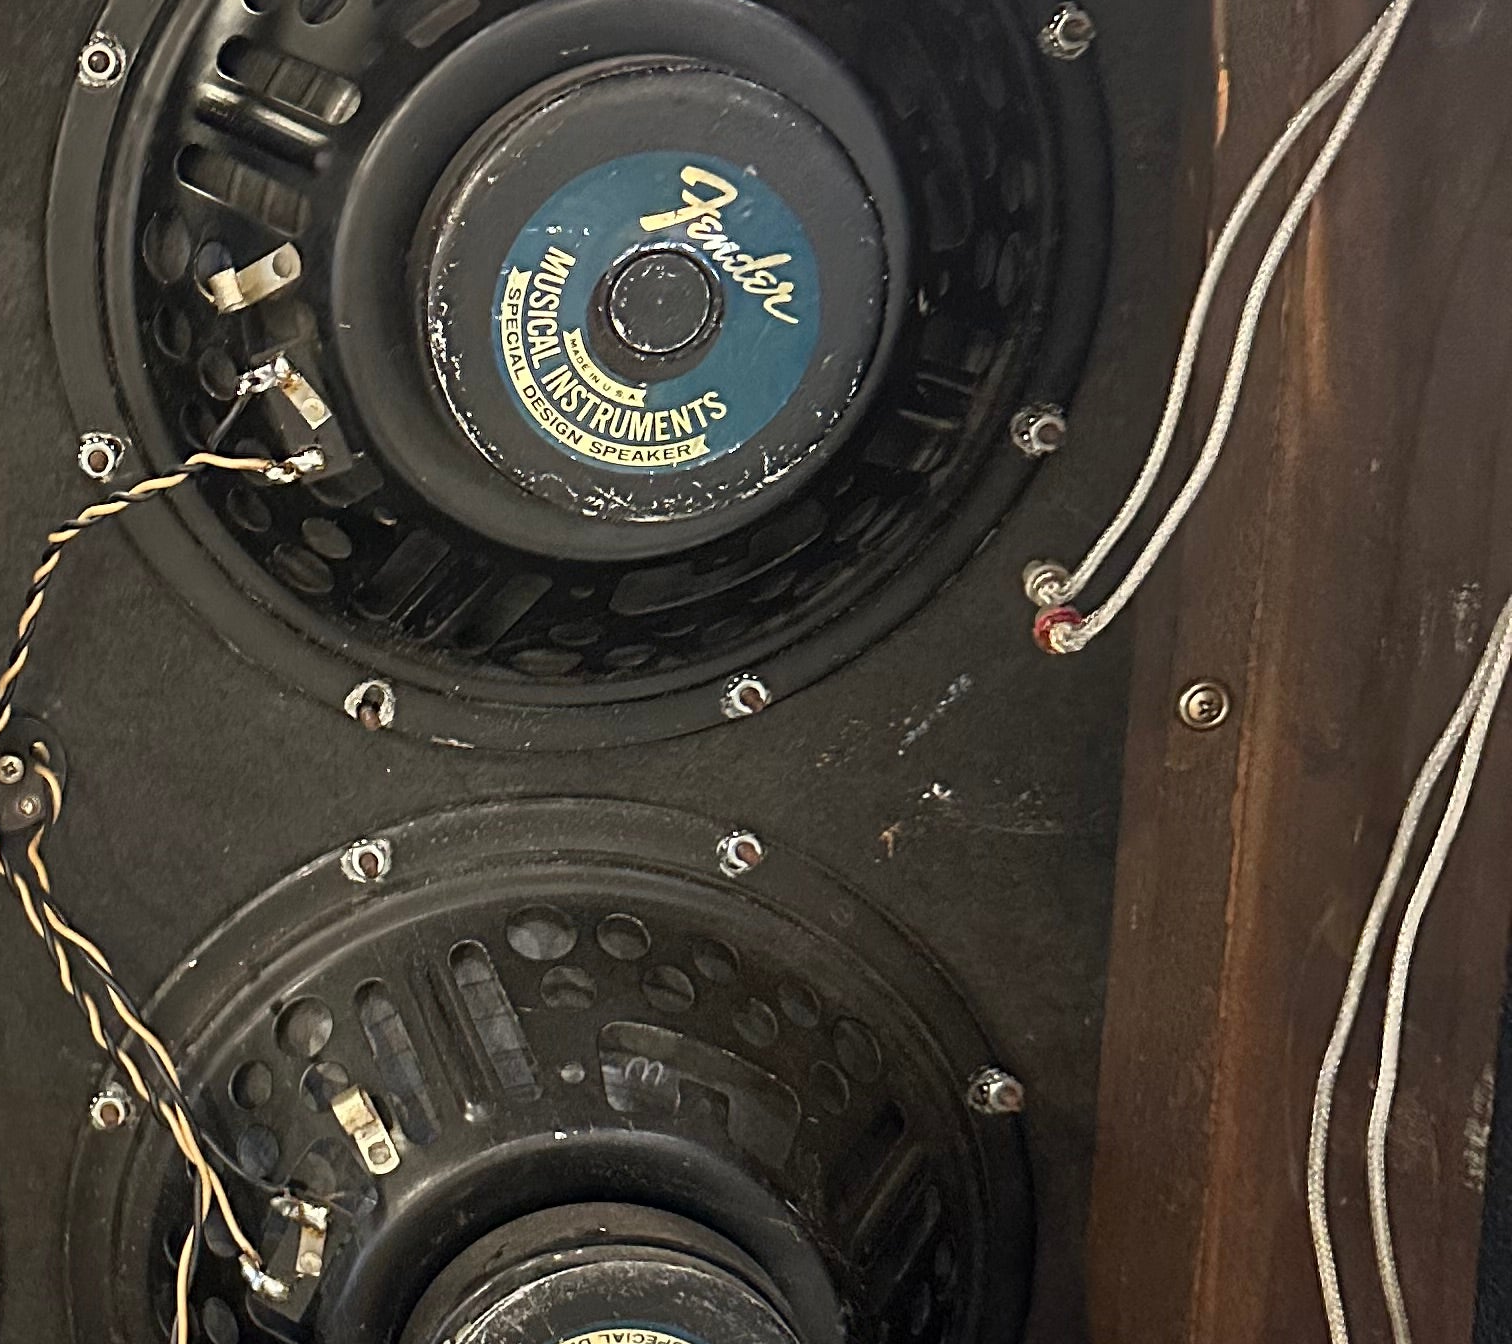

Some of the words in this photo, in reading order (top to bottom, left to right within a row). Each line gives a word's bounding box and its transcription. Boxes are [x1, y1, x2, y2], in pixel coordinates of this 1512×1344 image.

[640, 165, 799, 325] Fender
[526, 246, 576, 370] MUSICAL
[569, 338, 591, 372] MADE
[589, 371, 599, 384] IN
[506, 287, 523, 381] SPECIAL
[522, 384, 583, 445] DESIGN
[589, 441, 692, 463] SPEAKER
[541, 364, 728, 443] INSTRUMENTS
